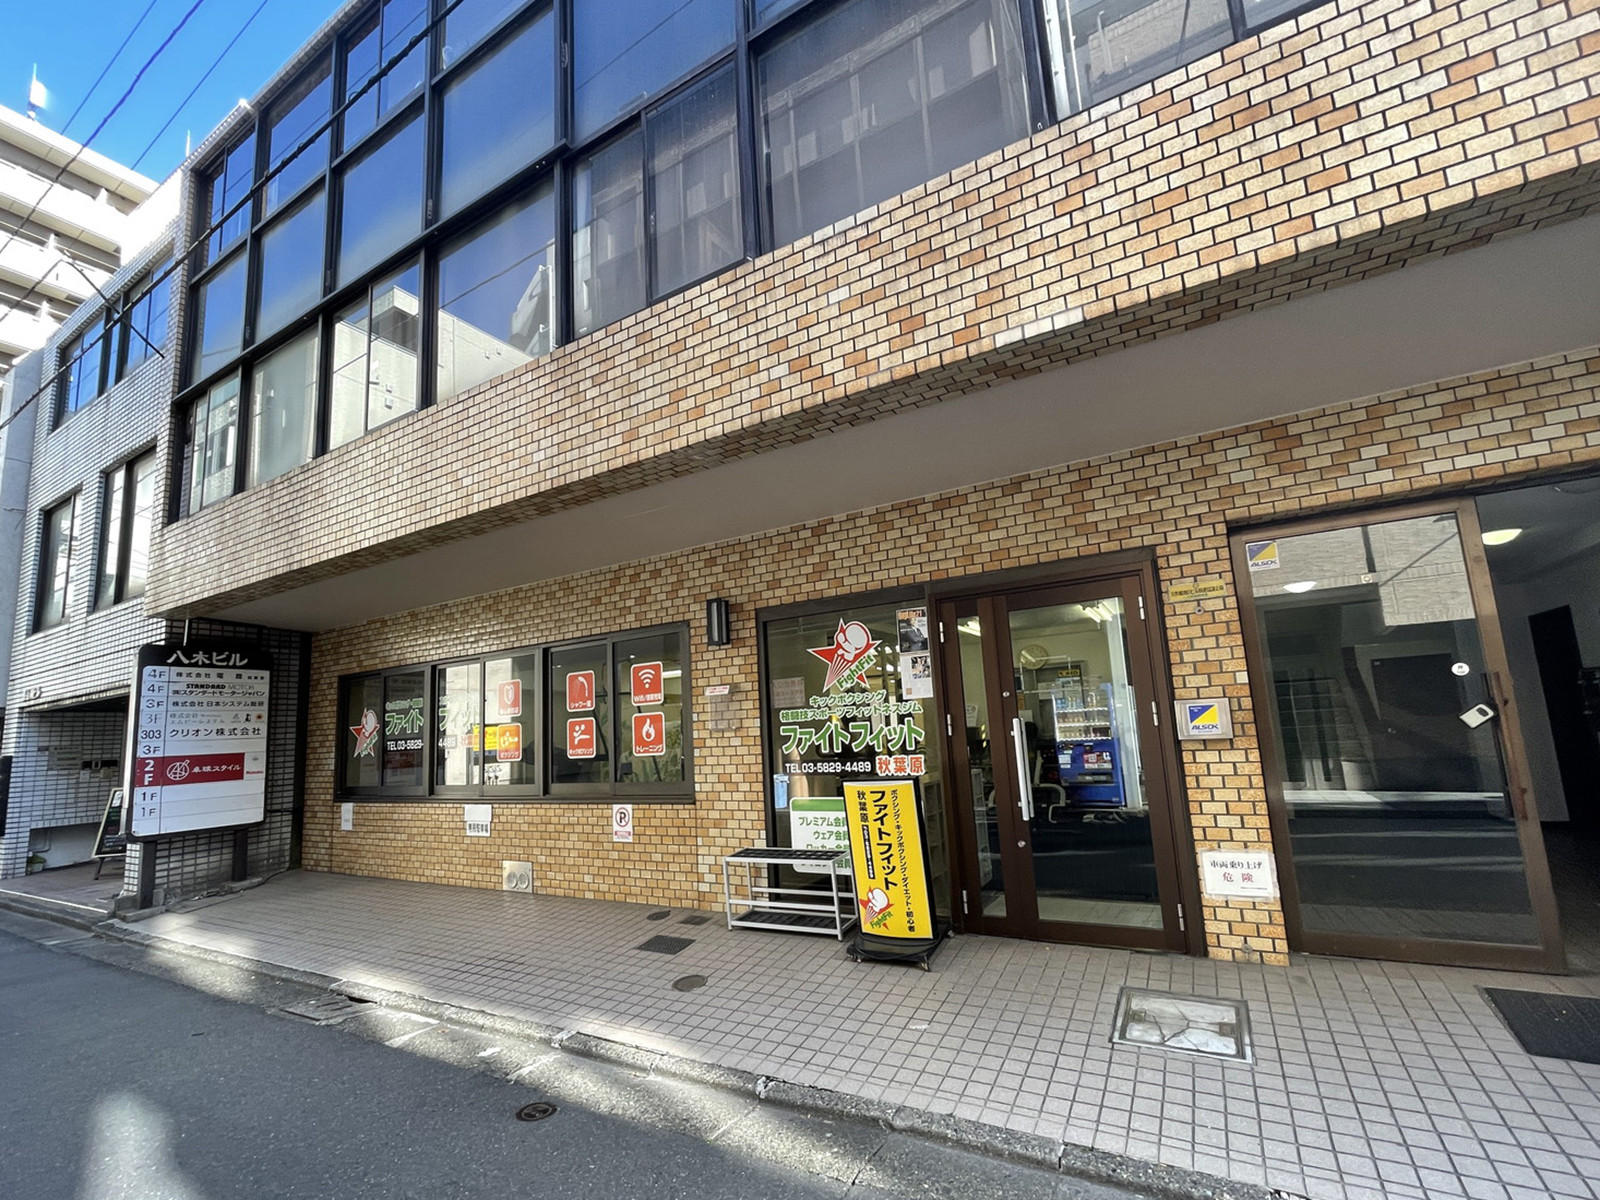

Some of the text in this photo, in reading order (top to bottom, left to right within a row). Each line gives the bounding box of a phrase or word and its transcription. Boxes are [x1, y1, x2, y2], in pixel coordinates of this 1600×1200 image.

[166, 650, 249, 667] 八木ビル
[147, 669, 167, 679] 4F
[836, 654, 875, 689] FightFit
[147, 684, 165, 694] 4F
[145, 699, 165, 708] 3F
[809, 690, 887, 708] キックボクシング
[780, 701, 923, 723] 格闘技スポーツフィットネスジム
[385, 708, 425, 735] ファイト
[140, 727, 262, 739] 303 クリオン株式会社
[780, 717, 925, 755] ファイトフィット
[142, 745, 161, 755] 3F
[635, 744, 663, 752] トレーニング
[785, 763, 801, 773] TEL
[876, 755, 925, 776] 秋葉原
[141, 792, 158, 802] 1F
[141, 807, 157, 817] 1F
[857, 790, 869, 823] 秋葉原
[813, 830, 849, 841] ウェア会員
[870, 790, 898, 890] ファイトフィット
[1210, 860, 1262, 869] 車両乗り上げ
